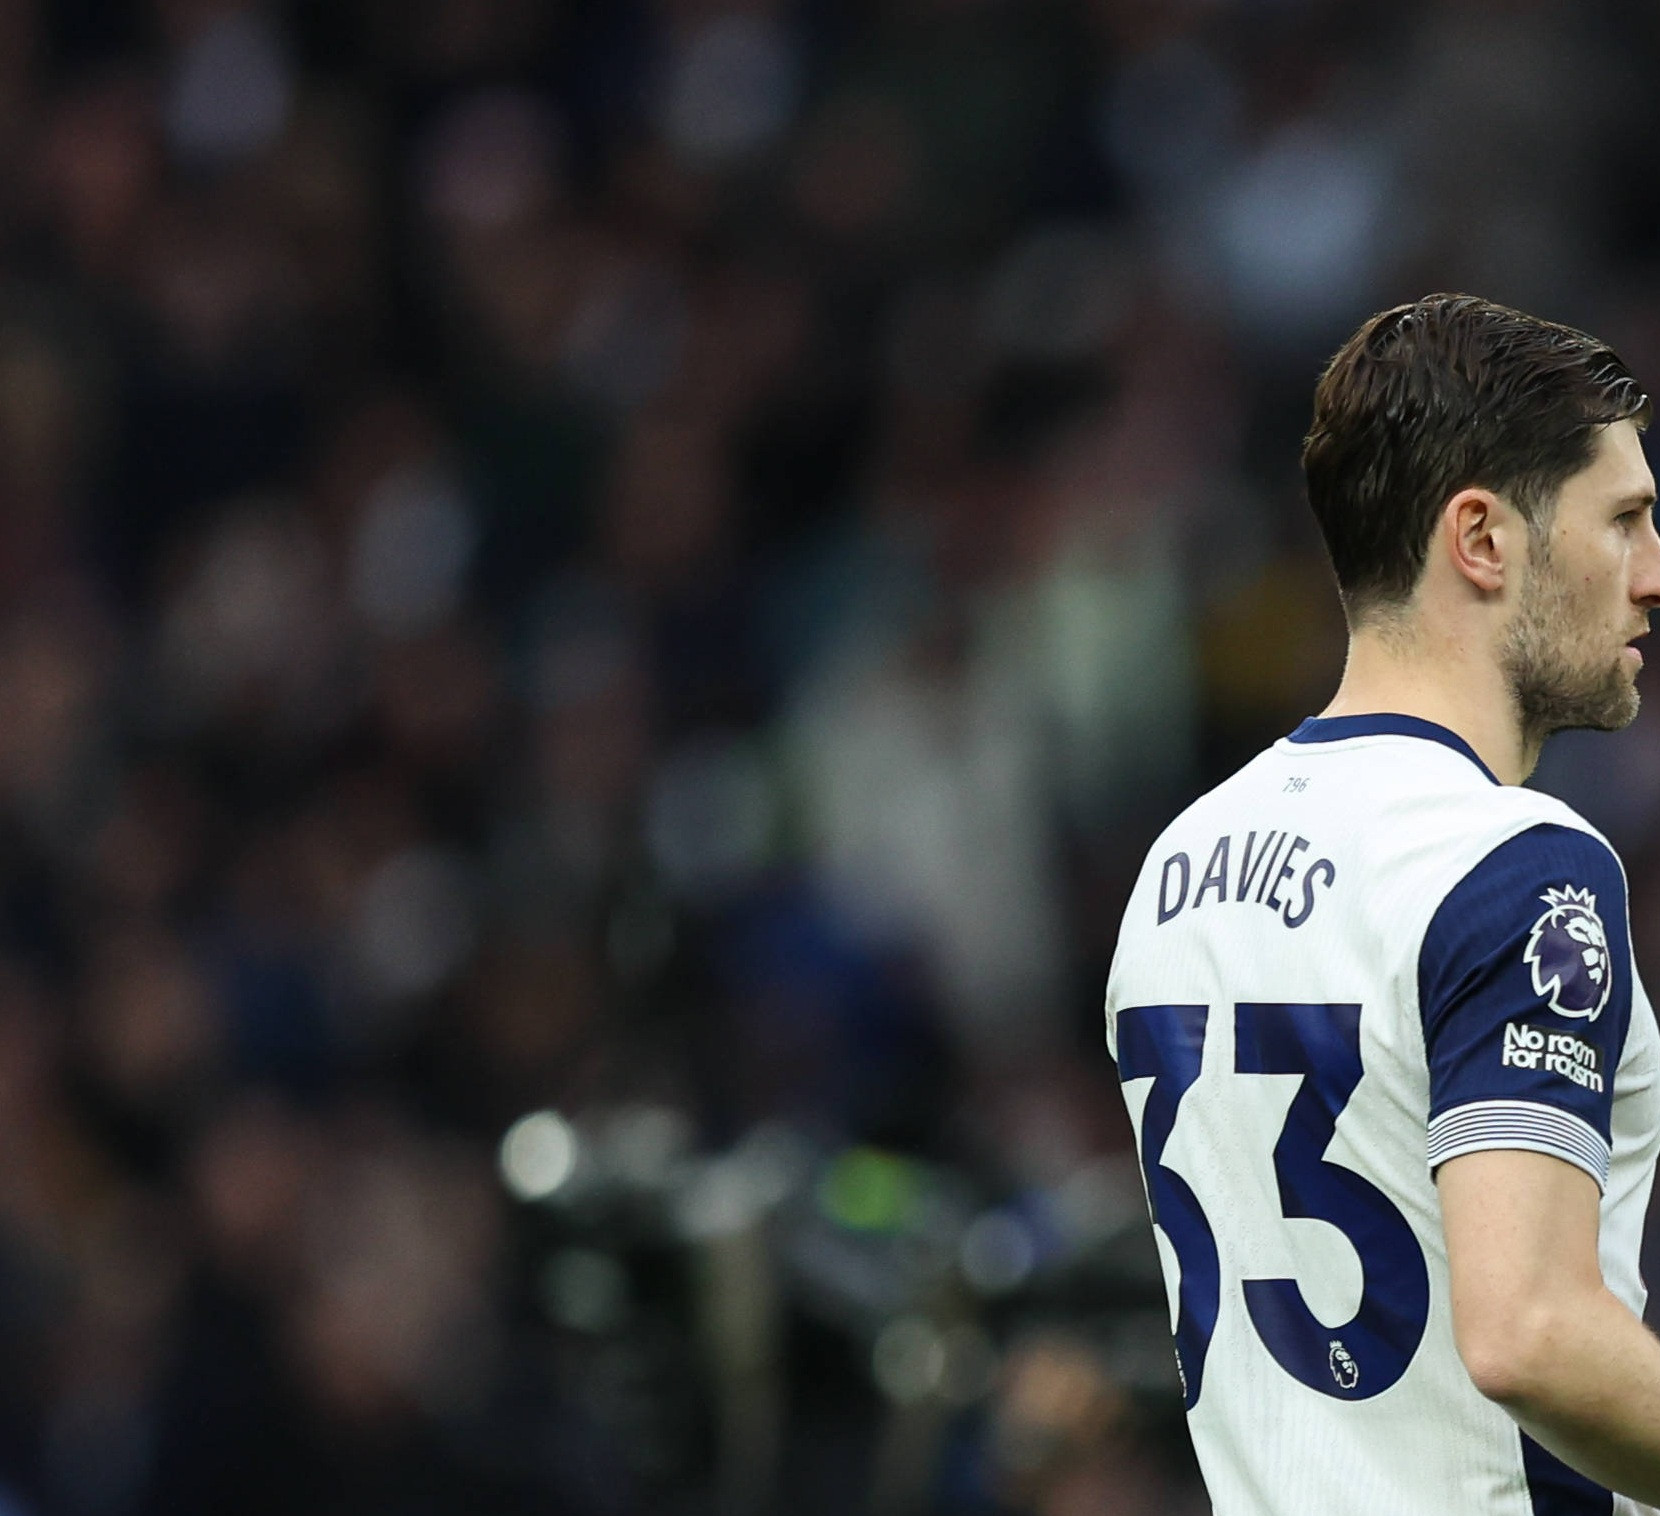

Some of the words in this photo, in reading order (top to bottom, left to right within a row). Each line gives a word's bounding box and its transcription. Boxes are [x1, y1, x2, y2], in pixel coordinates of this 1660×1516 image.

[1157, 830, 1336, 929] DAVIES
[1502, 1043, 1543, 1069] for
[1503, 1022, 1544, 1051] No
[1547, 1034, 1597, 1069] room
[1115, 1002, 1430, 1412] 33
